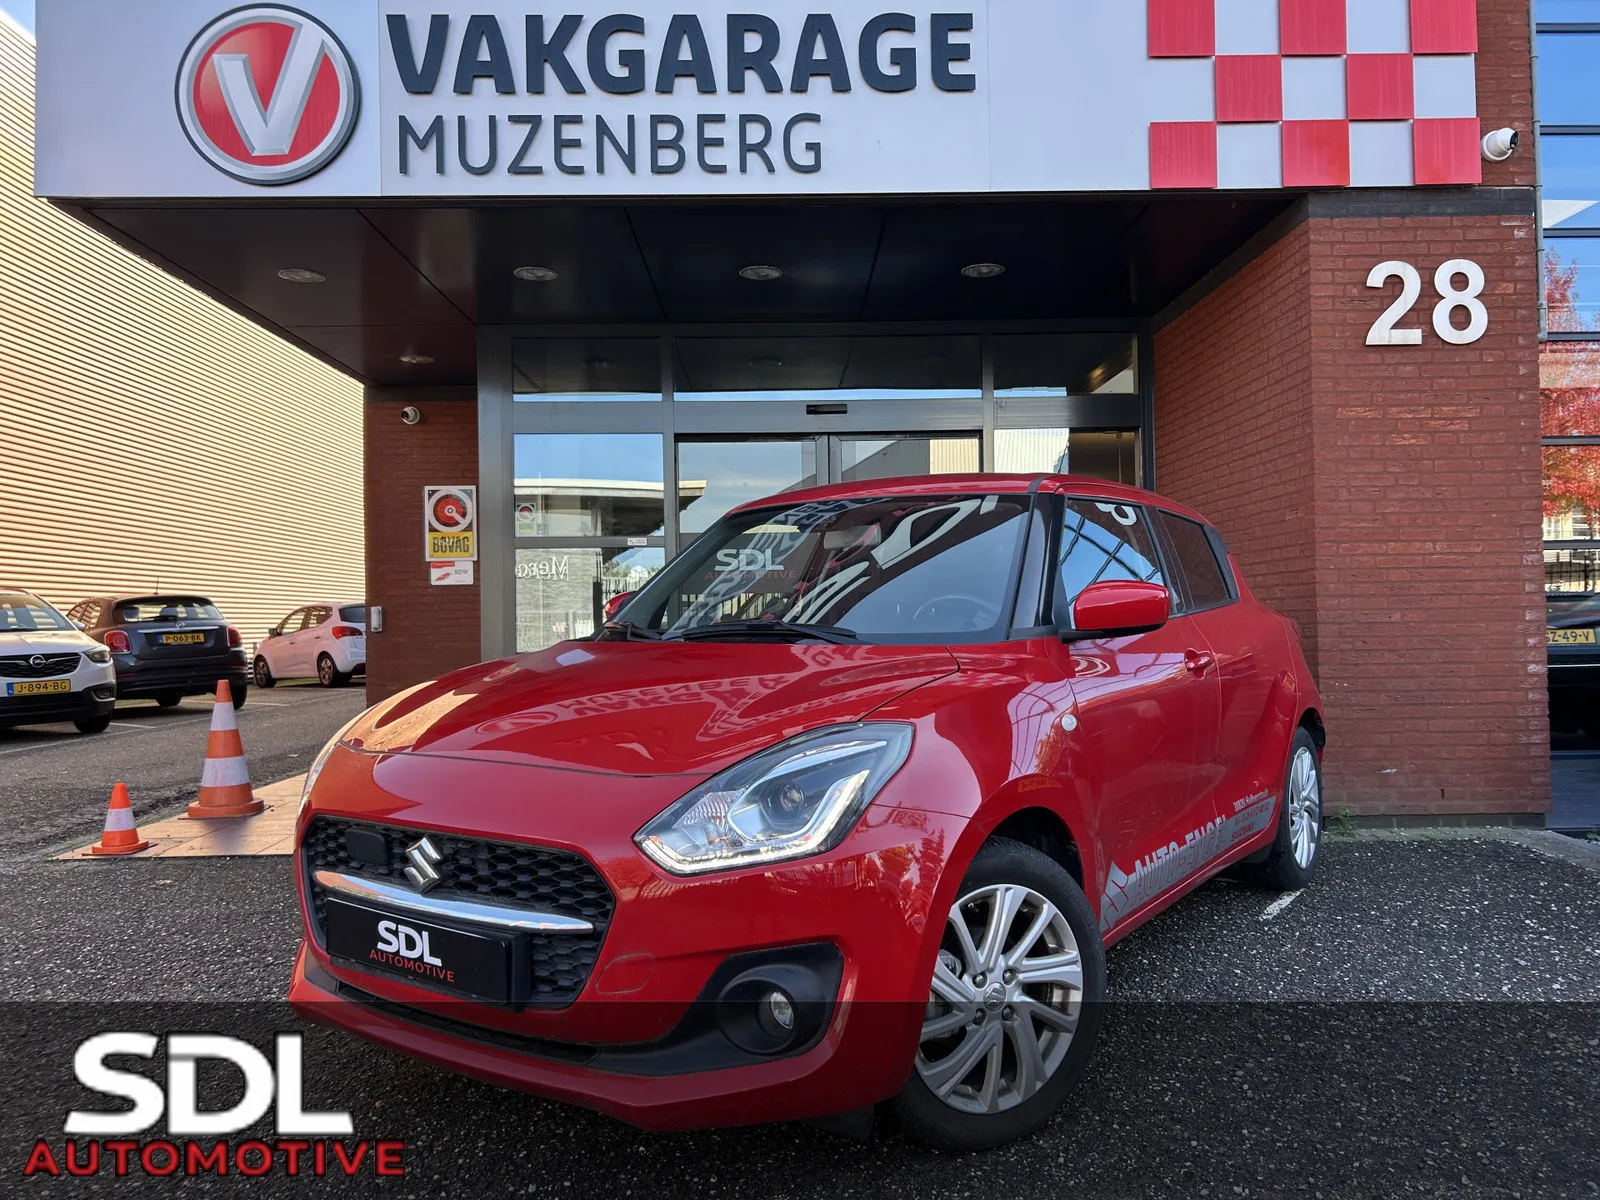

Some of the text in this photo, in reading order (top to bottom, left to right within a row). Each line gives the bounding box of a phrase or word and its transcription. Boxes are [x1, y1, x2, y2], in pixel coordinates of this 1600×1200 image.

[386, 12, 976, 95] VAKGARAGE
[211, 22, 326, 158] V
[398, 112, 822, 175] MUZENBERG
[1365, 258, 1489, 345] 28
[433, 536, 470, 553] BOVAG
[165, 634, 202, 643] P-063-BK
[18, 681, 67, 693] J-894-BG
[370, 949, 455, 982] AUTOMOTIVE
[377, 920, 442, 966] SDL
